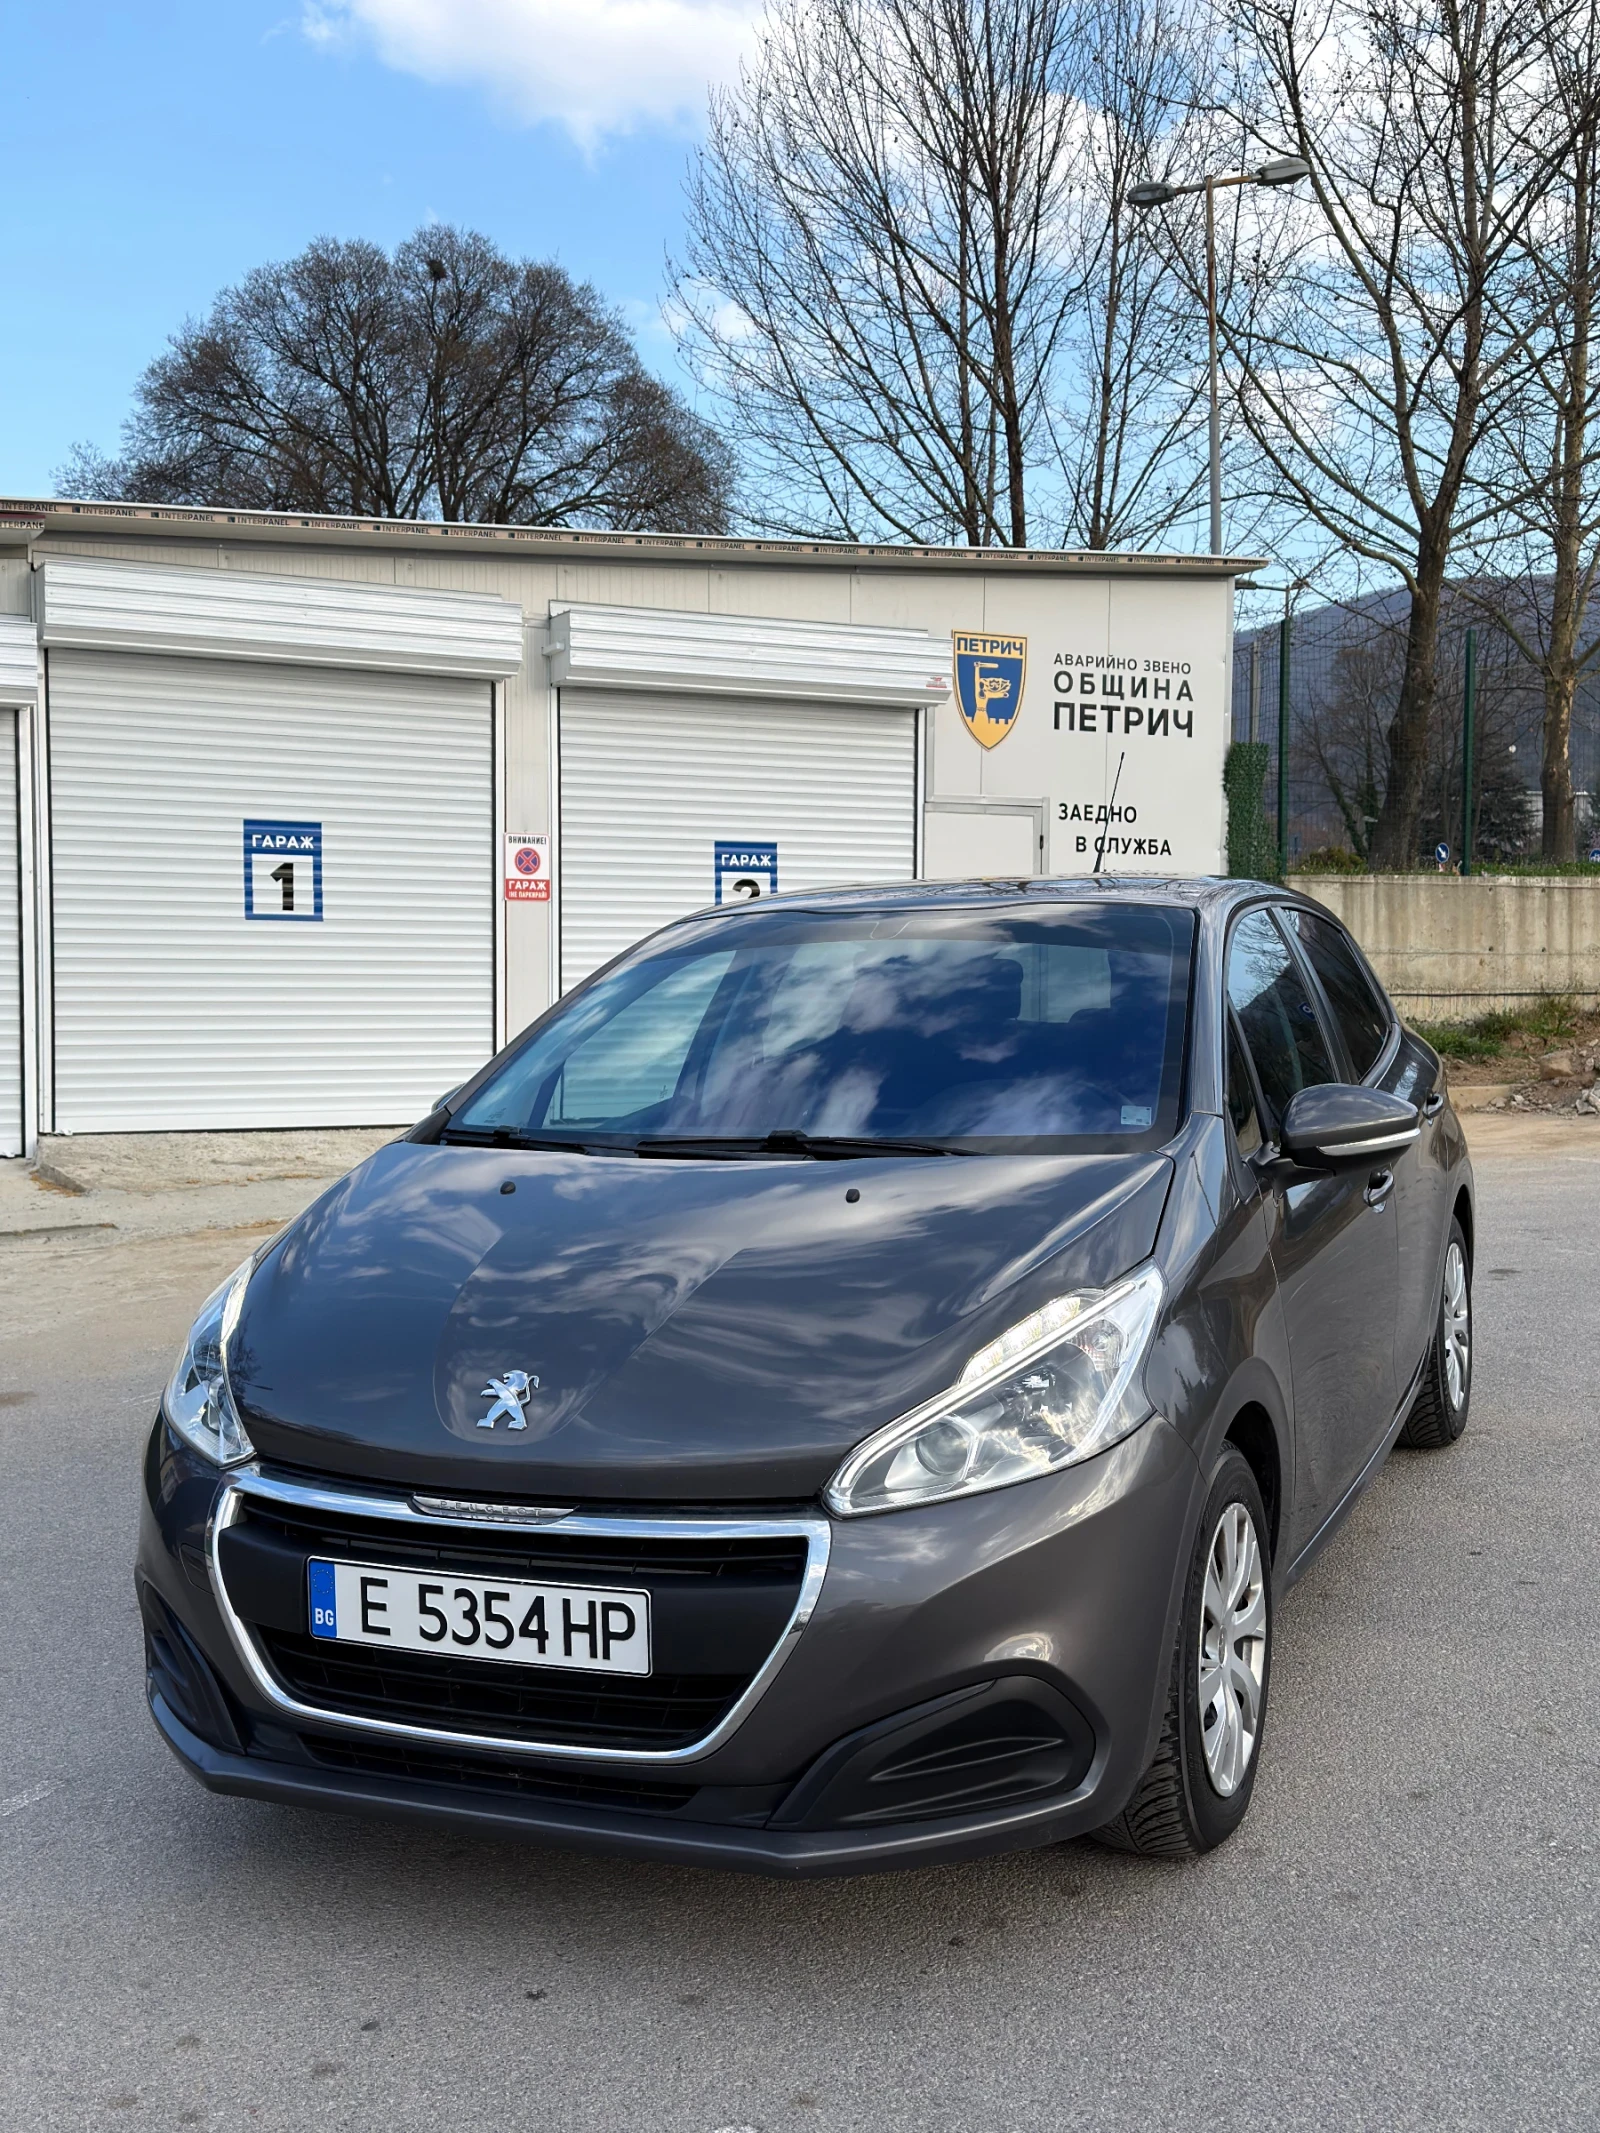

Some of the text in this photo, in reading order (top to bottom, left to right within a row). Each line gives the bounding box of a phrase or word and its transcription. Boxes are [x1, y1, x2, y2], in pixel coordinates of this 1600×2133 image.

[0, 520, 44, 528] TERPANE
[1, 502, 59, 512] INTERPANEL
[82, 506, 138, 517] INTERPANEL
[161, 512, 216, 522] INTERPANEL
[237, 516, 290, 526] INTERPANEL
[310, 520, 362, 530] INTERPANEL
[382, 525, 430, 534] INTERPANEL
[450, 529, 497, 538] INTERPANEL
[516, 532, 562, 541] INTERPANEL
[580, 536, 626, 544] INTERPANEL
[643, 539, 686, 547] INTERPANEL
[704, 542, 746, 550] INTERPANEL
[762, 544, 804, 552] INTERPANEL
[820, 547, 860, 555] INTERPANEL
[930, 550, 968, 558] INTERPANEL
[956, 636, 1024, 656] ПЕТРИЧ
[1053, 653, 1192, 675] АВАРИЙНО ЗВЕНО
[1053, 670, 1194, 702] ОБЩИНА
[1053, 702, 1194, 738] ПЕТРИЧ
[1058, 803, 1137, 824] ЗАЕДНО
[251, 834, 314, 849] ГАРАЖ
[508, 836, 547, 845] ВНИМАНИЕ!
[1075, 836, 1172, 856] В СЛУЖБА
[721, 854, 772, 867] ГАРАЖ
[270, 862, 294, 911] 1
[508, 880, 547, 890] ГАРАЖ
[439, 1500, 544, 1517] PEUGEOT
[314, 1607, 335, 1626] BG
[360, 1576, 636, 1661] E 5354 HP
